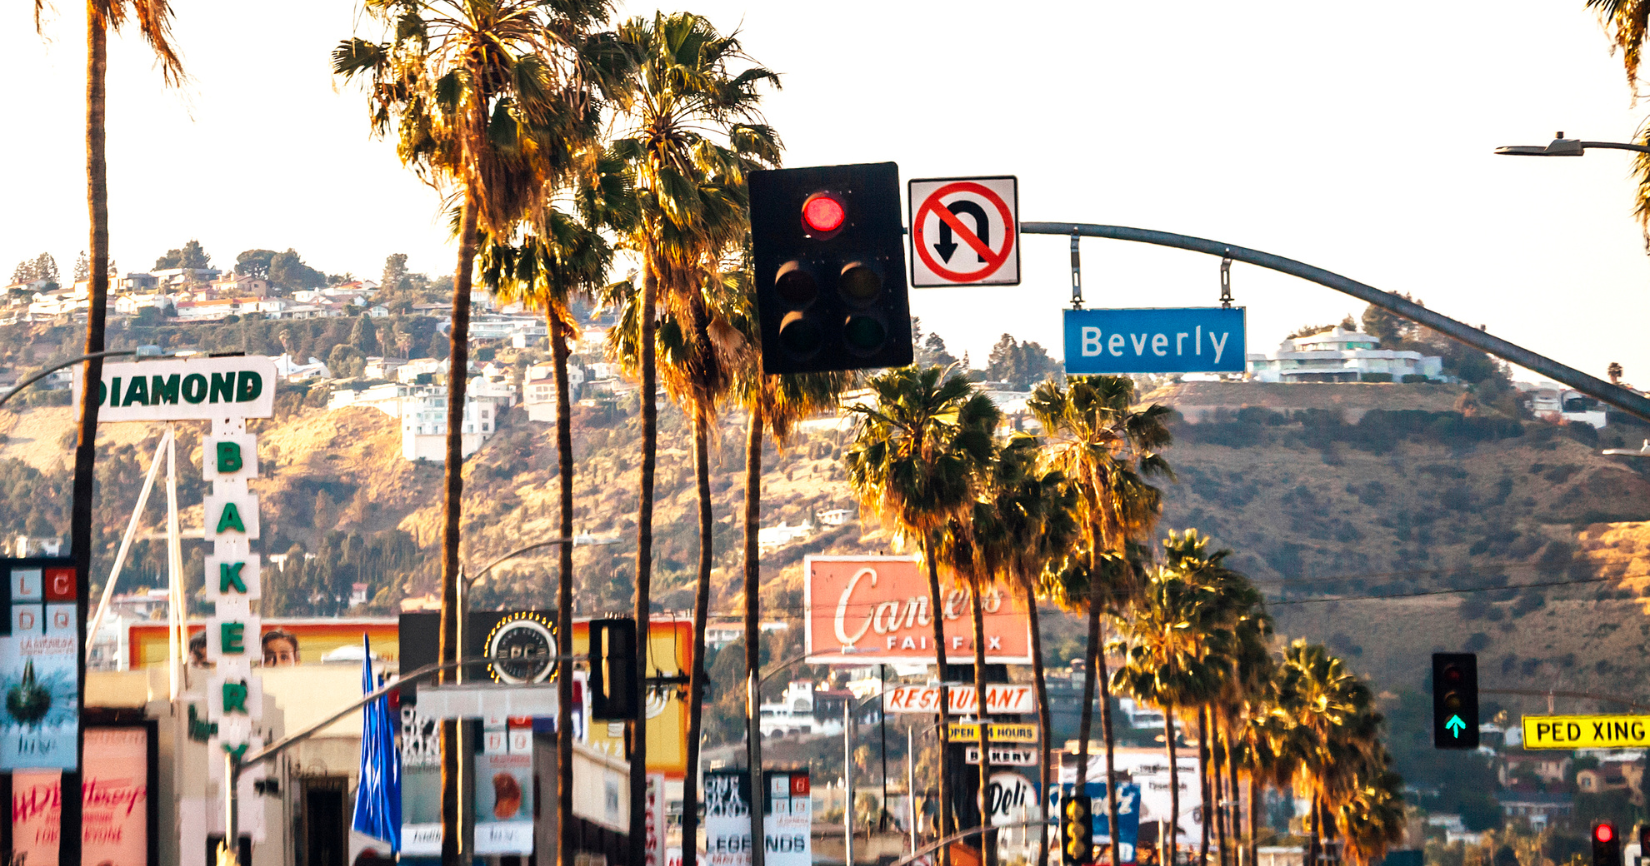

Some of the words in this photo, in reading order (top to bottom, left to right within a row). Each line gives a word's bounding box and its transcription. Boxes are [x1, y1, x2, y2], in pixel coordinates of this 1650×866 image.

[1080, 323, 1230, 364] Beverly
[53, 573, 70, 595] C
[997, 727, 1033, 739] HOURS
[1536, 722, 1582, 742] PED
[1592, 721, 1646, 741] XING
[970, 751, 1031, 762] BKERY
[988, 780, 1027, 816] Deli
